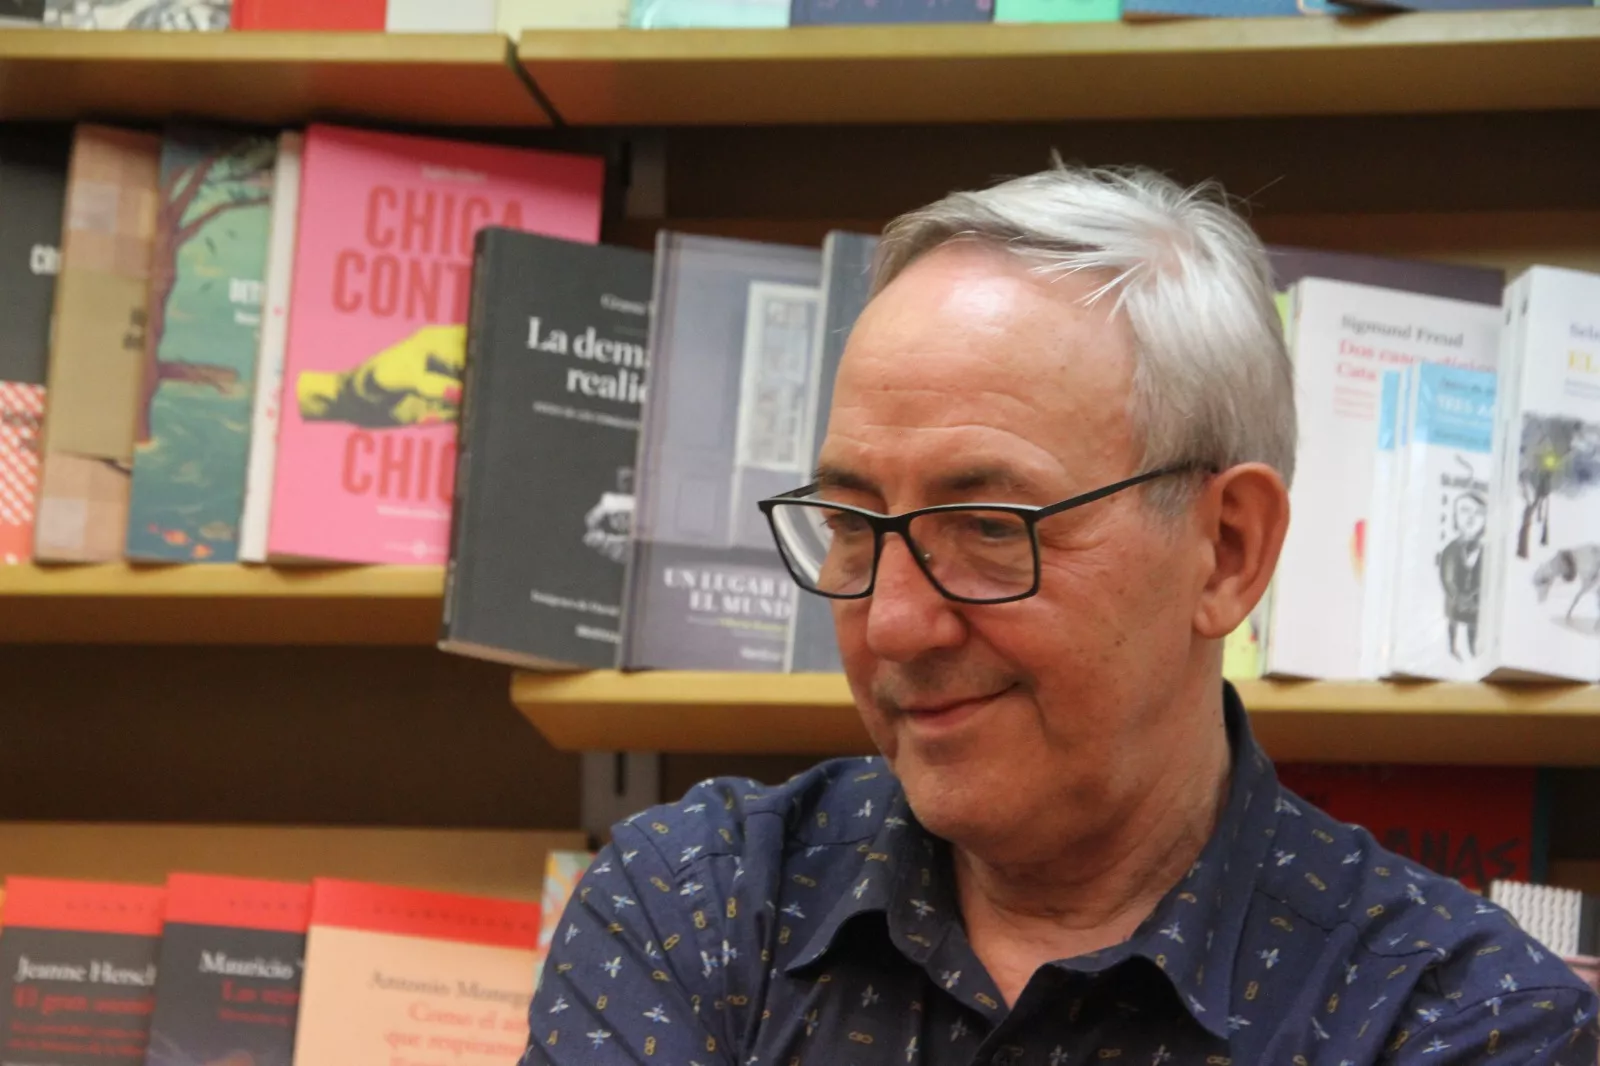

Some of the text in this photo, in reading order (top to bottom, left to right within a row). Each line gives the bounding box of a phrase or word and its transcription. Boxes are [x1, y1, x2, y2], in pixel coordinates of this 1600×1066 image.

[331, 248, 470, 323] CONT
[526, 315, 568, 355] La
[1342, 315, 1465, 349] Sigmund Freud
[663, 567, 696, 590] UN
[701, 571, 775, 597] LUGAR
[689, 591, 718, 613] EL
[199, 950, 294, 980] Mauricio
[366, 970, 449, 996] Antonio
